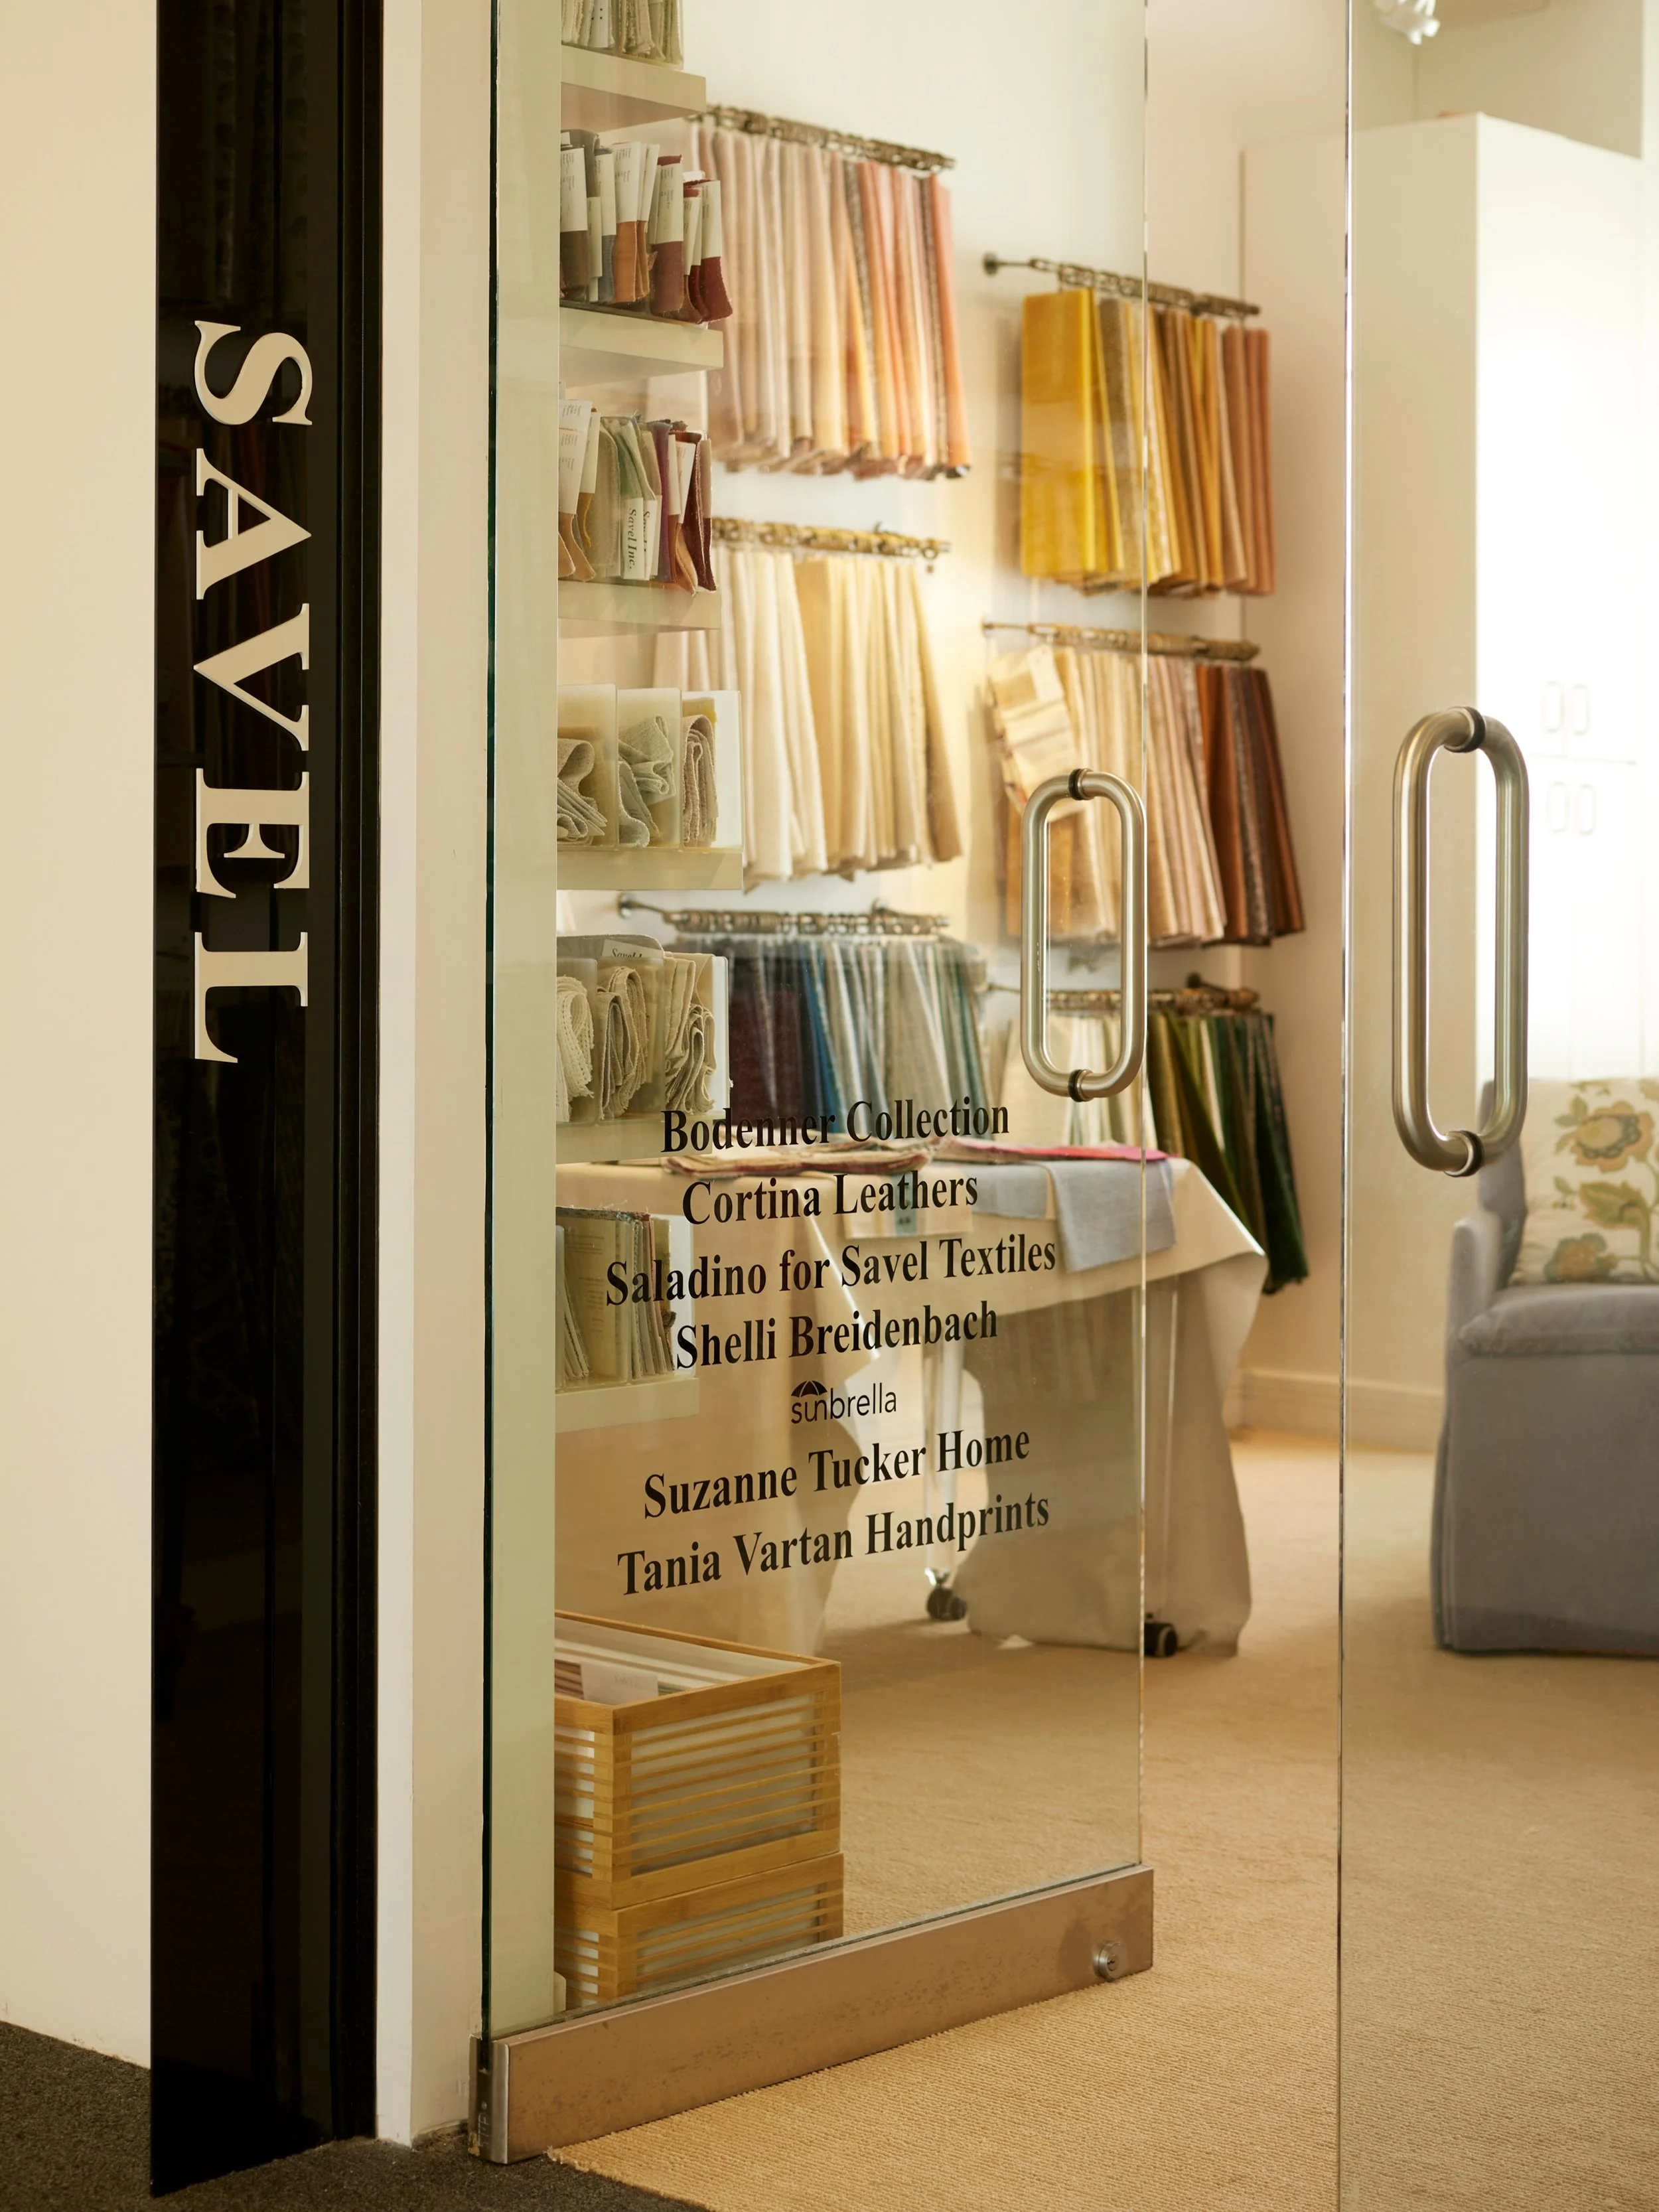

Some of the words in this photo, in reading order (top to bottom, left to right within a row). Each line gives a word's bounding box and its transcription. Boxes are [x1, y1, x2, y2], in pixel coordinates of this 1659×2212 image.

[628, 509, 637, 542] Savel
[628, 545, 637, 569] Inc.
[194, 320, 313, 1063] SAVEL
[661, 1108, 836, 1153] Bodenner
[847, 1097, 1009, 1142] Collection
[682, 1177, 822, 1225] Cortina
[833, 1170, 978, 1215] Leathers
[606, 1255, 766, 1307] Saladino
[779, 1249, 830, 1291] for
[841, 1241, 928, 1287] Savel
[939, 1234, 1056, 1278] Textiles
[676, 1317, 777, 1369] Shelli
[788, 1300, 998, 1358] Breidenbach
[790, 1381, 897, 1424] sunbrella
[644, 1467, 797, 1519] Suzanne
[808, 1443, 927, 1492] Tucker
[936, 1430, 1031, 1473] Home
[617, 1541, 722, 1595] Tania
[733, 1529, 853, 1576] Vartan
[865, 1493, 1049, 1555] Handprints
